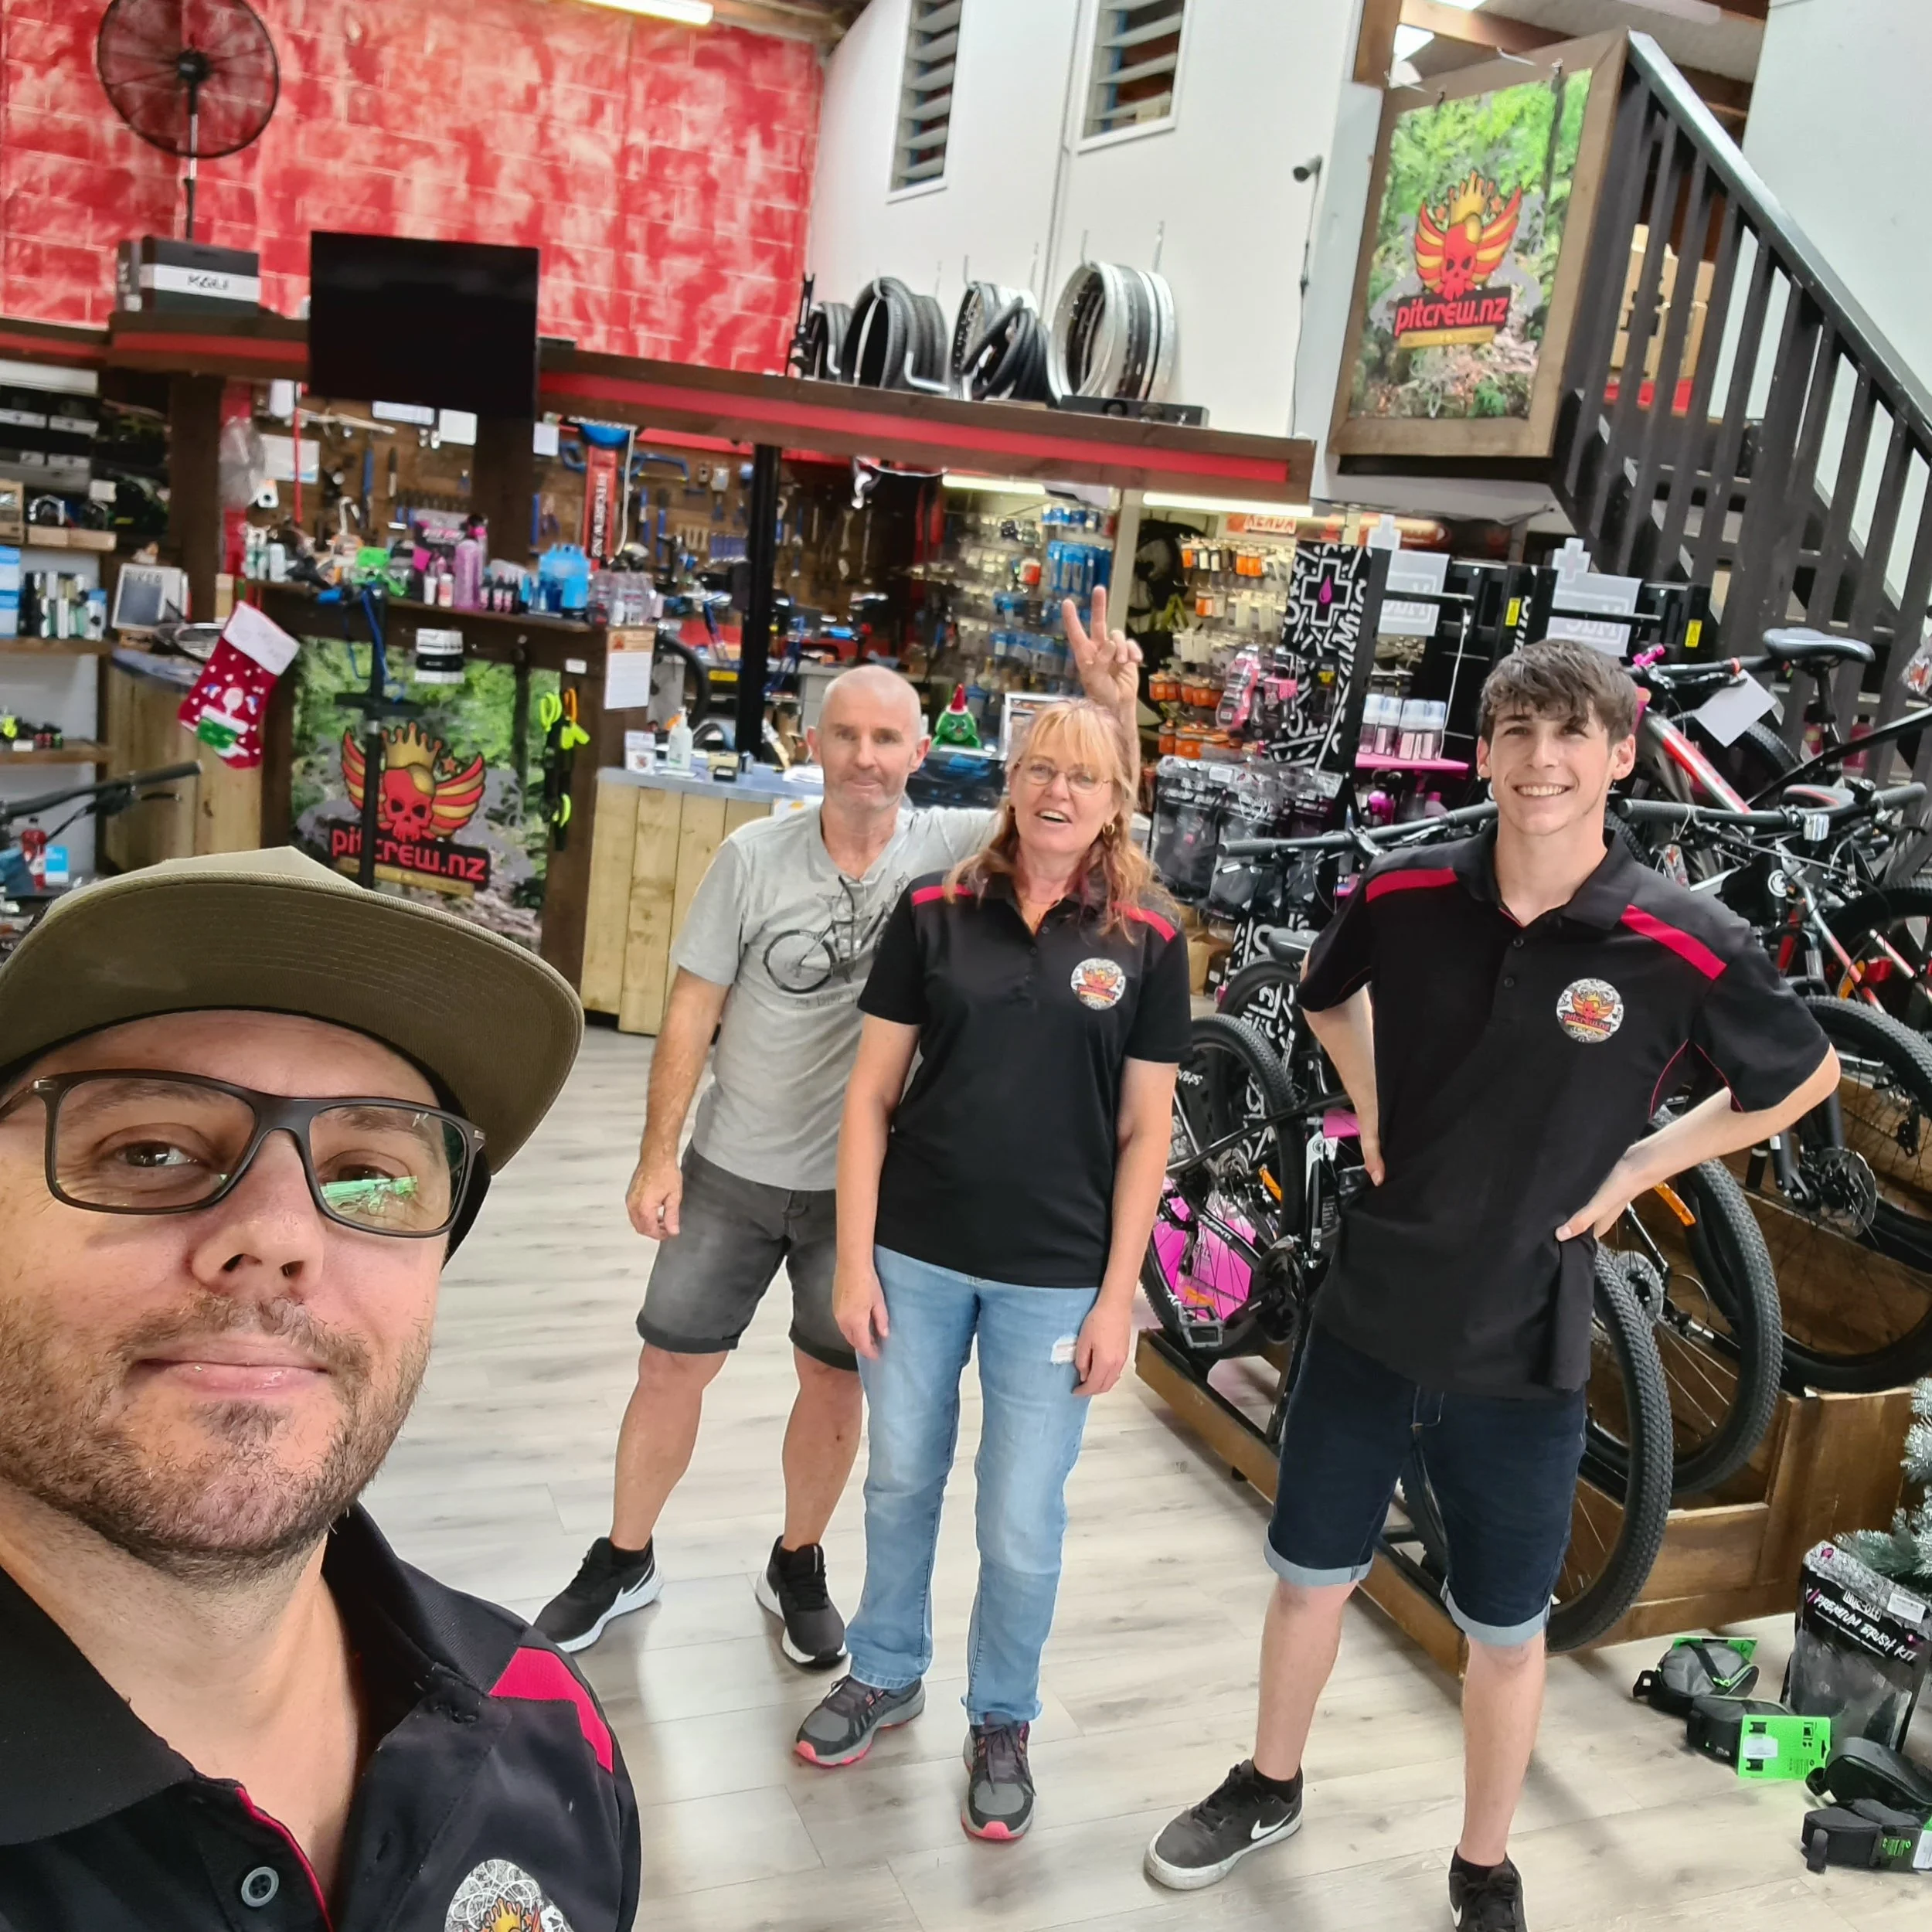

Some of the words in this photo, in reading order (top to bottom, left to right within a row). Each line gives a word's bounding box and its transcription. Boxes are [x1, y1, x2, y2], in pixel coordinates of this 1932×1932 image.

[1394, 297, 1509, 338] pitcrew.nz
[1859, 1623, 1897, 1652] BRUSH
[1893, 1645, 1917, 1662] KIT
